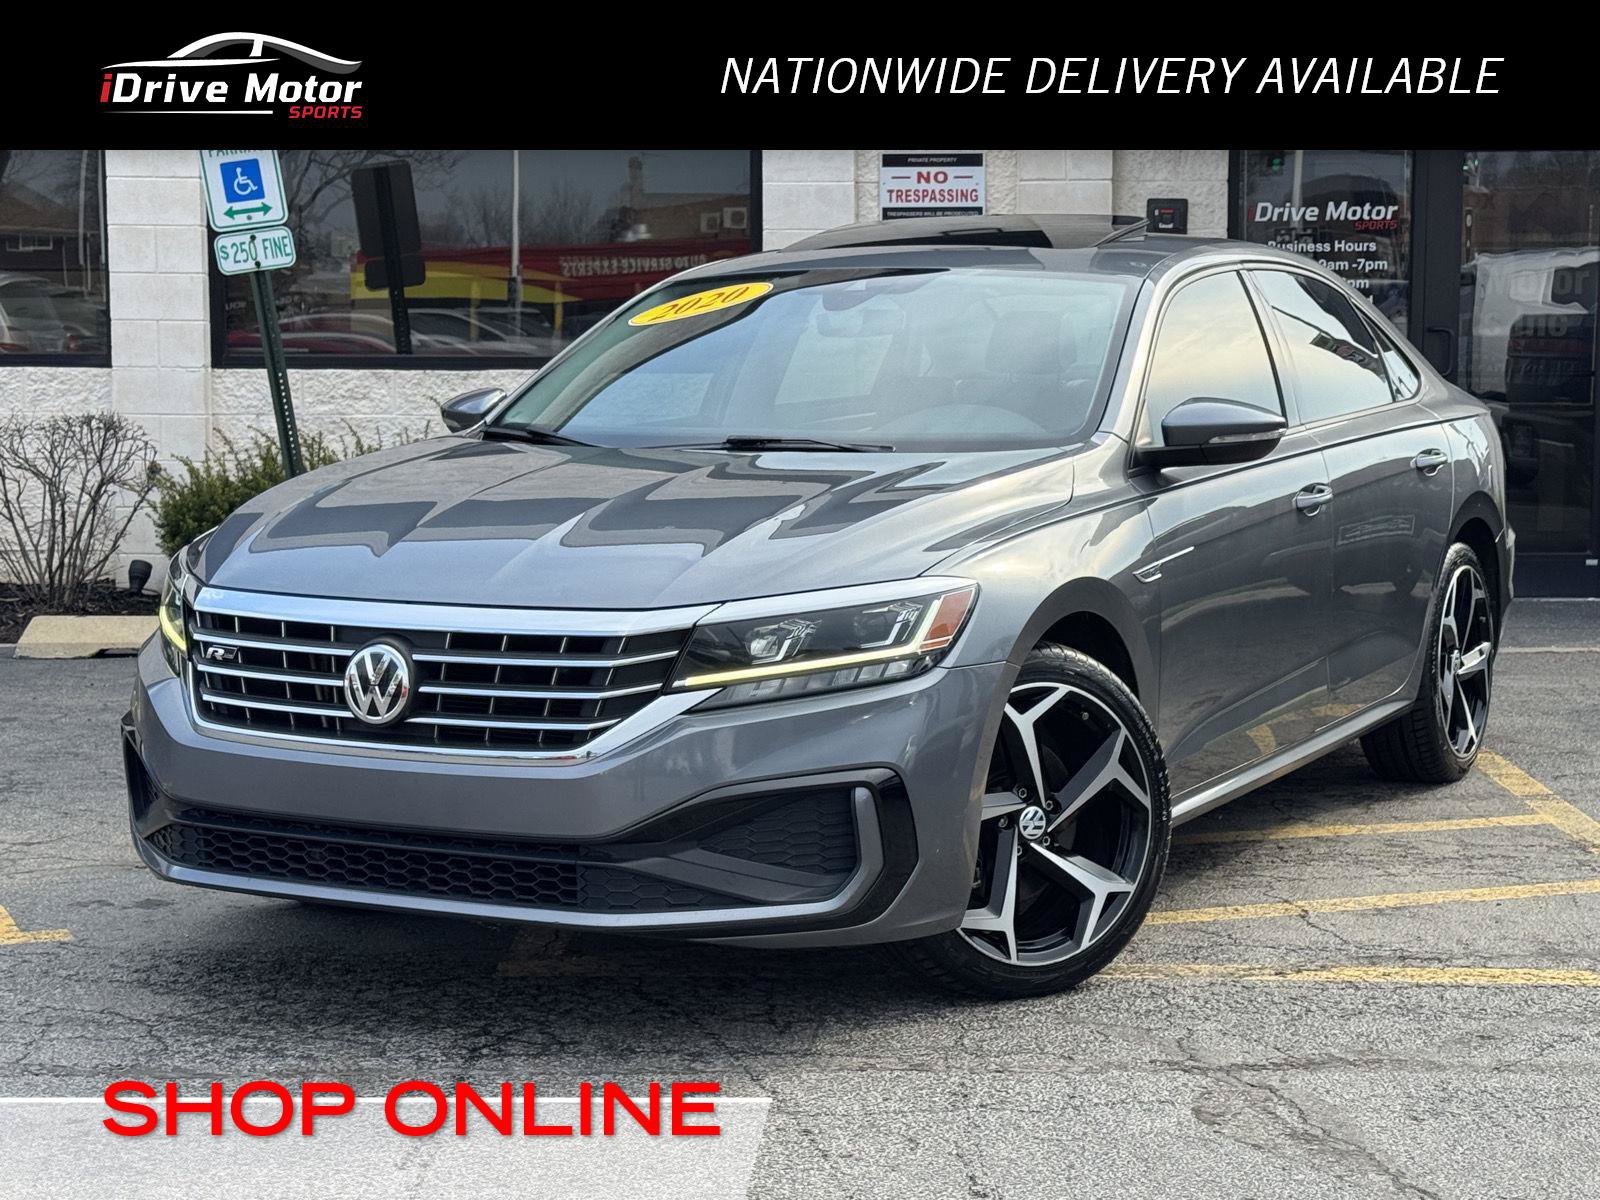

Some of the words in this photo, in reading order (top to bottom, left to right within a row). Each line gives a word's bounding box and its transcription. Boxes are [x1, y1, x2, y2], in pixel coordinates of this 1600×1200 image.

[916, 171, 949, 184] NO
[887, 189, 979, 203] TRESPASSING
[1325, 201, 1398, 221] Motor
[1355, 220, 1398, 231] SPORTS
[262, 236, 292, 260] FINE
[1334, 240, 1376, 252] Hours
[647, 286, 750, 322] 2020
